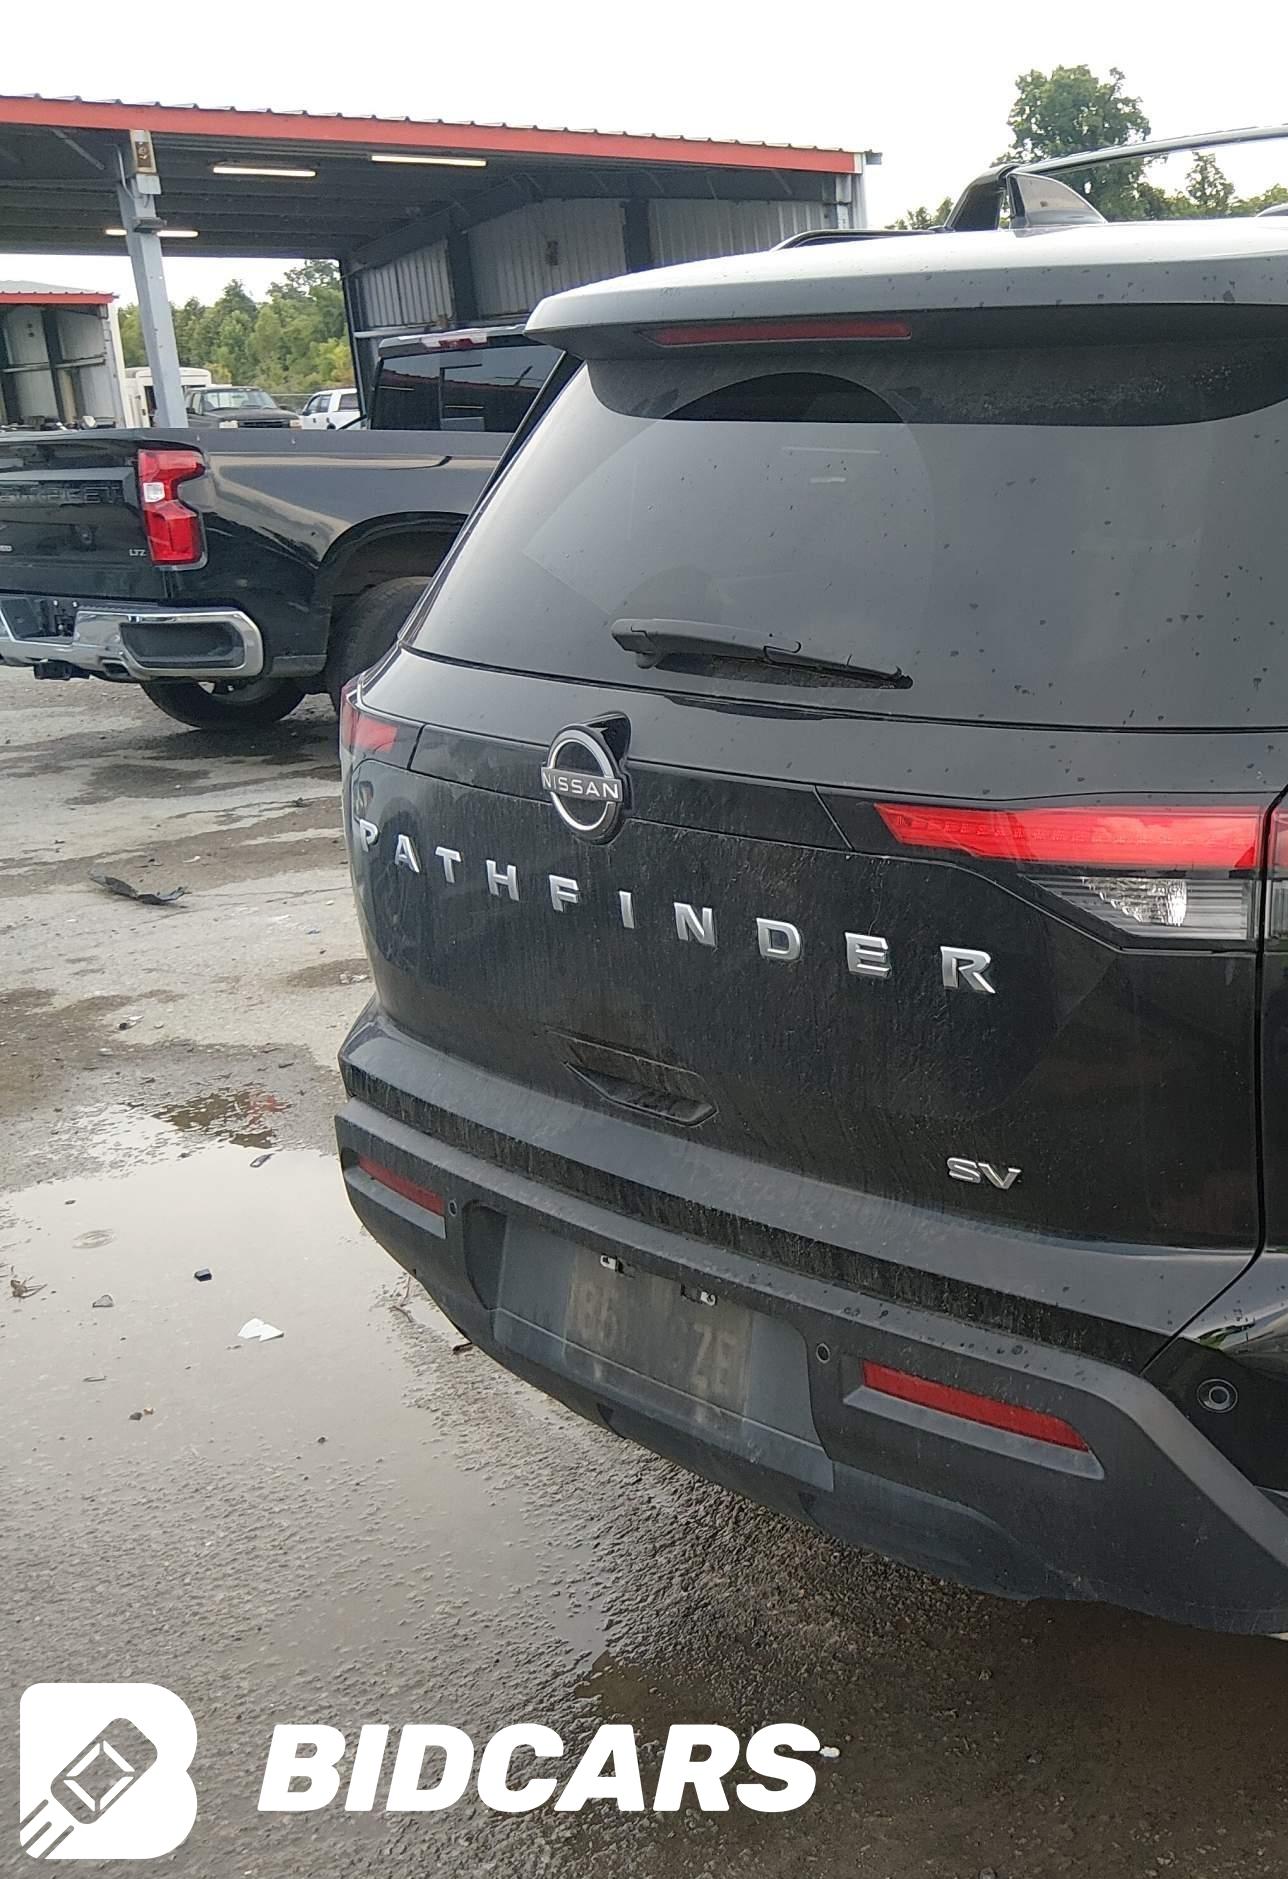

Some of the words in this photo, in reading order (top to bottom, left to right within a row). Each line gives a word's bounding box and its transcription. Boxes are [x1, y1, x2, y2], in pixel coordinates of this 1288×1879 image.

[542, 771, 619, 799] NISSAN
[359, 819, 996, 994] PATHFINDER
[946, 1157, 1022, 1190] SV
